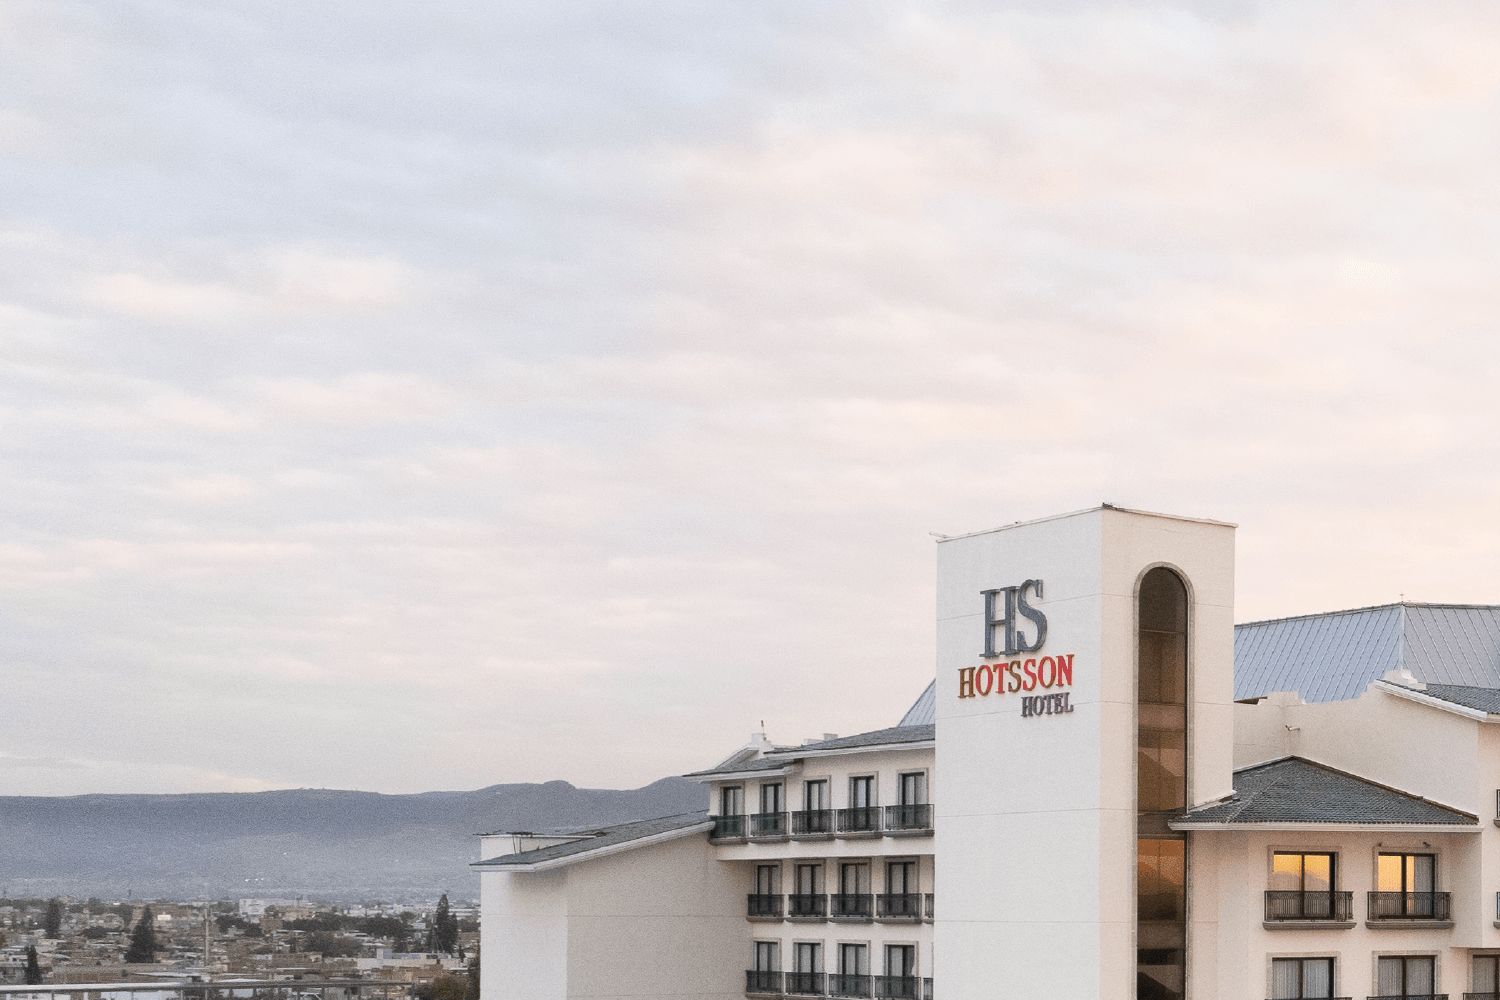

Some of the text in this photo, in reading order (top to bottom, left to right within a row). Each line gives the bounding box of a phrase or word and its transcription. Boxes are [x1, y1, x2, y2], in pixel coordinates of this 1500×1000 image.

[979, 579, 1048, 659] HS
[957, 654, 1075, 699] HOTSSON
[1020, 692, 1074, 718] HOTEL
